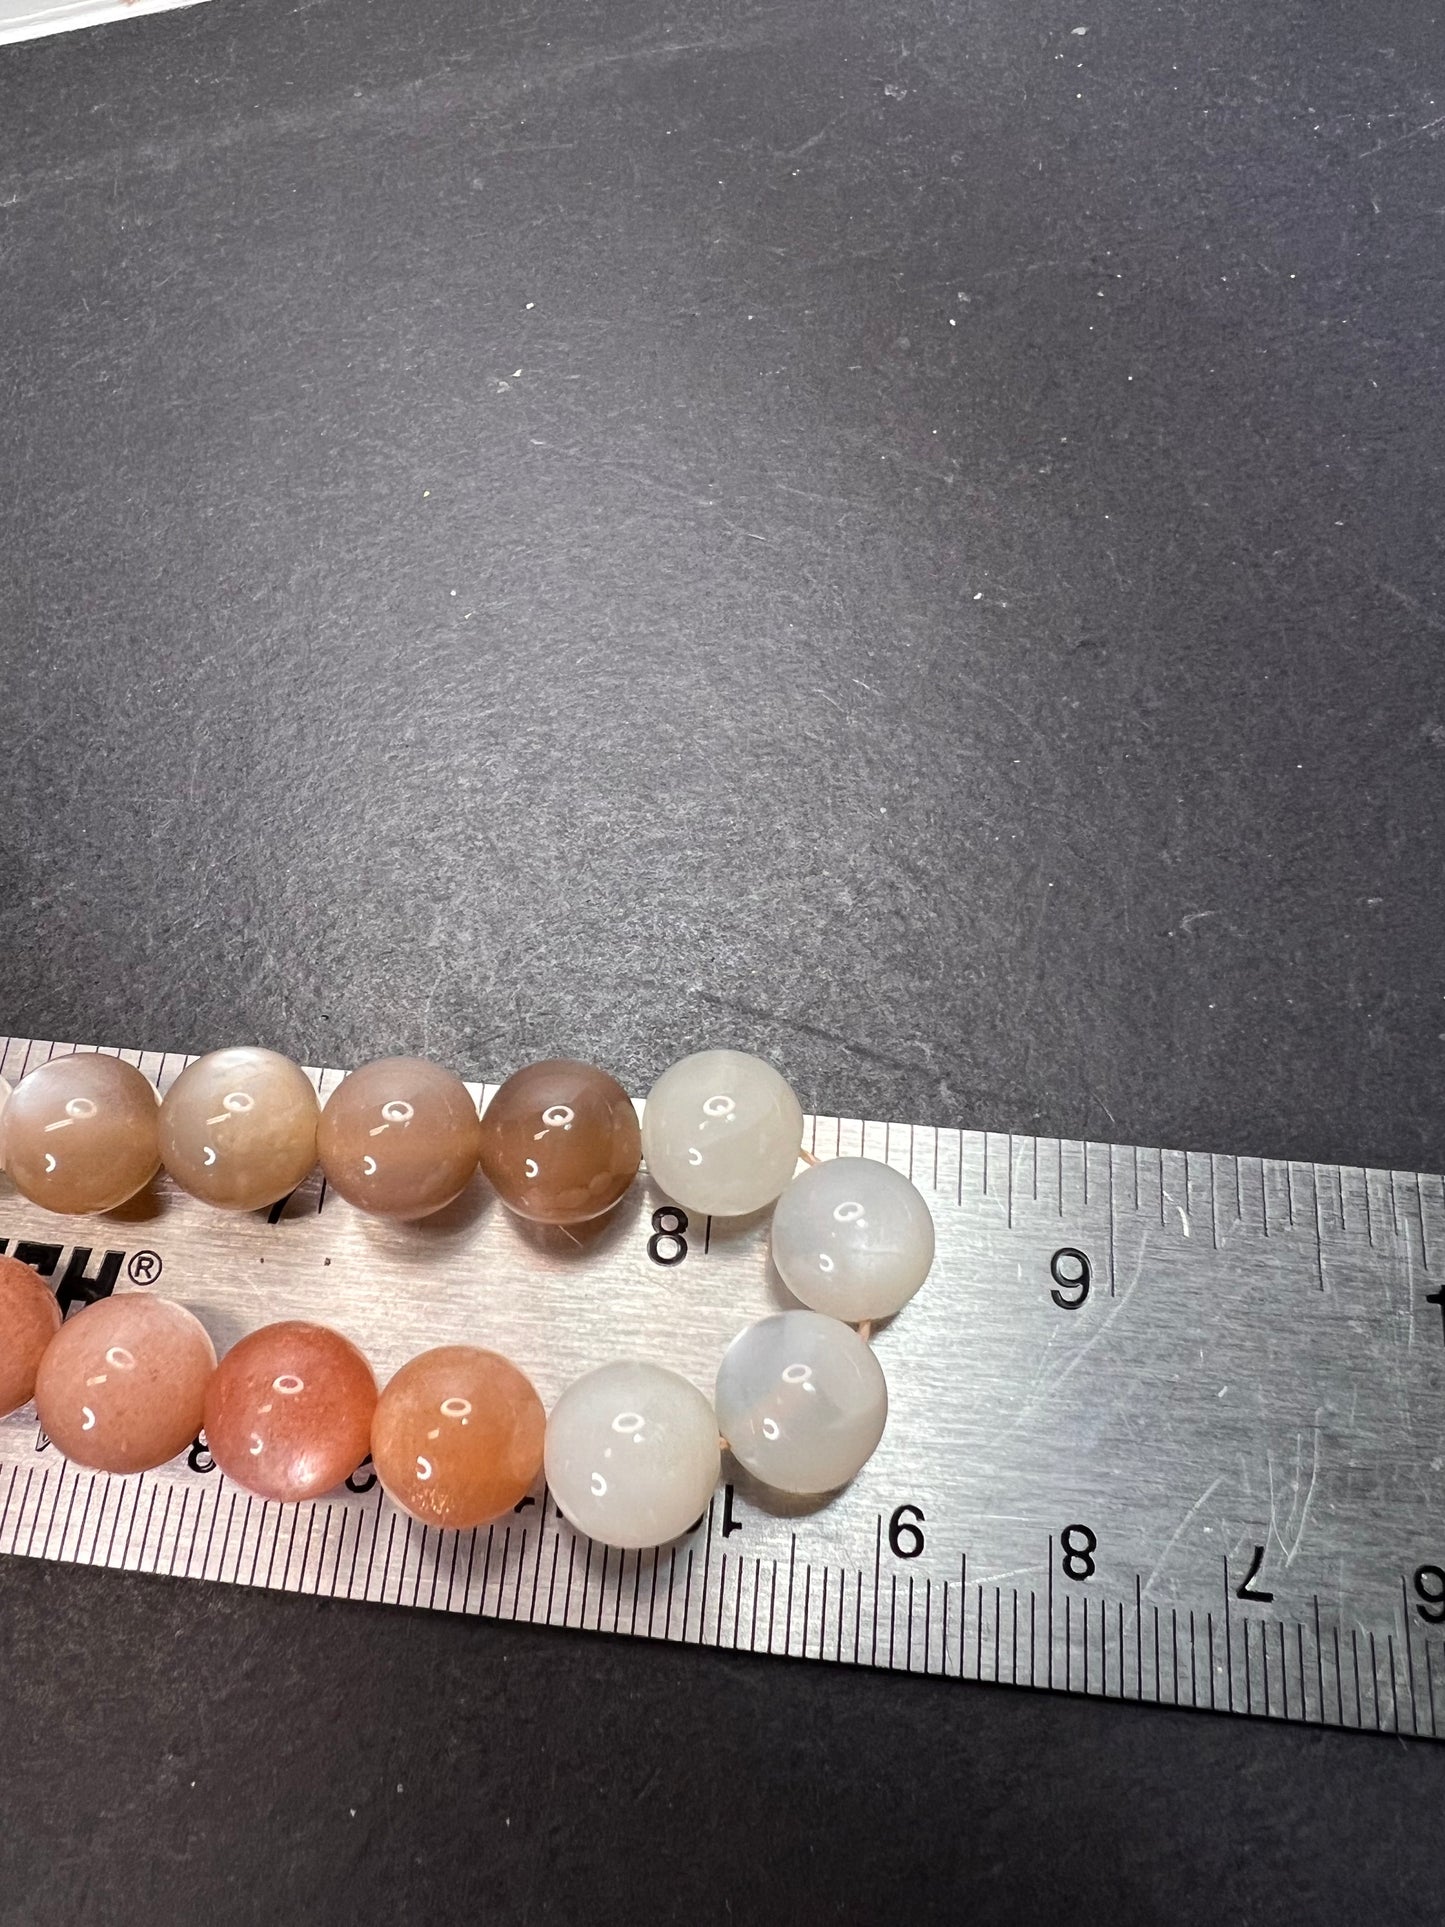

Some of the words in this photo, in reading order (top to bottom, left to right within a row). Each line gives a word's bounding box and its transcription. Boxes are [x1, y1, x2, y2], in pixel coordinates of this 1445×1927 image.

[647, 1206, 689, 1266] 8
[1050, 1247, 1092, 1310] 9
[1060, 1523, 1097, 1581] 8
[1237, 1545, 1274, 1603] 7
